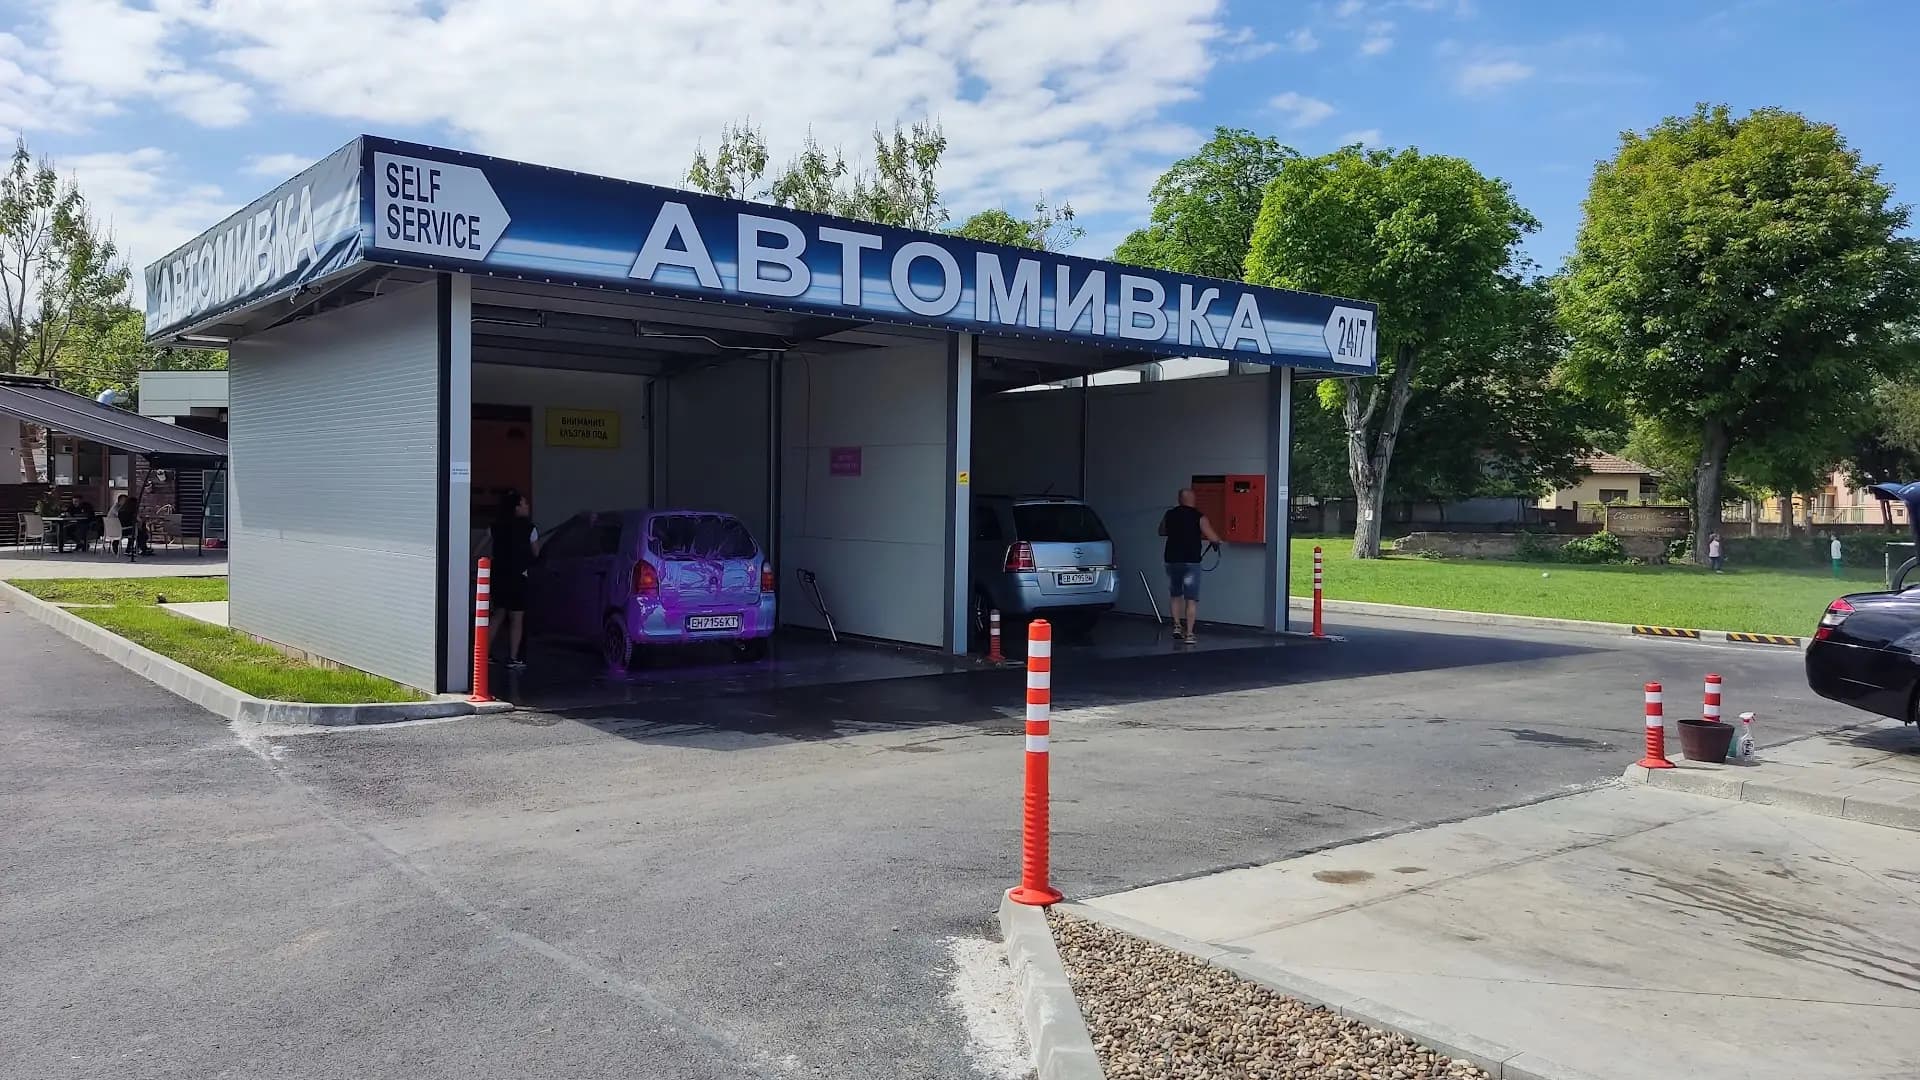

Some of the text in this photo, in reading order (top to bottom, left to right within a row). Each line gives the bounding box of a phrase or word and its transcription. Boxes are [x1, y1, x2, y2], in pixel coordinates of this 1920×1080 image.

[386, 161, 442, 204] SELF
[386, 203, 482, 251] SERVICE
[156, 183, 319, 330] АВТОМИВКА
[627, 200, 1273, 355] АВТОМИВКА
[1337, 315, 1368, 360] 24/7
